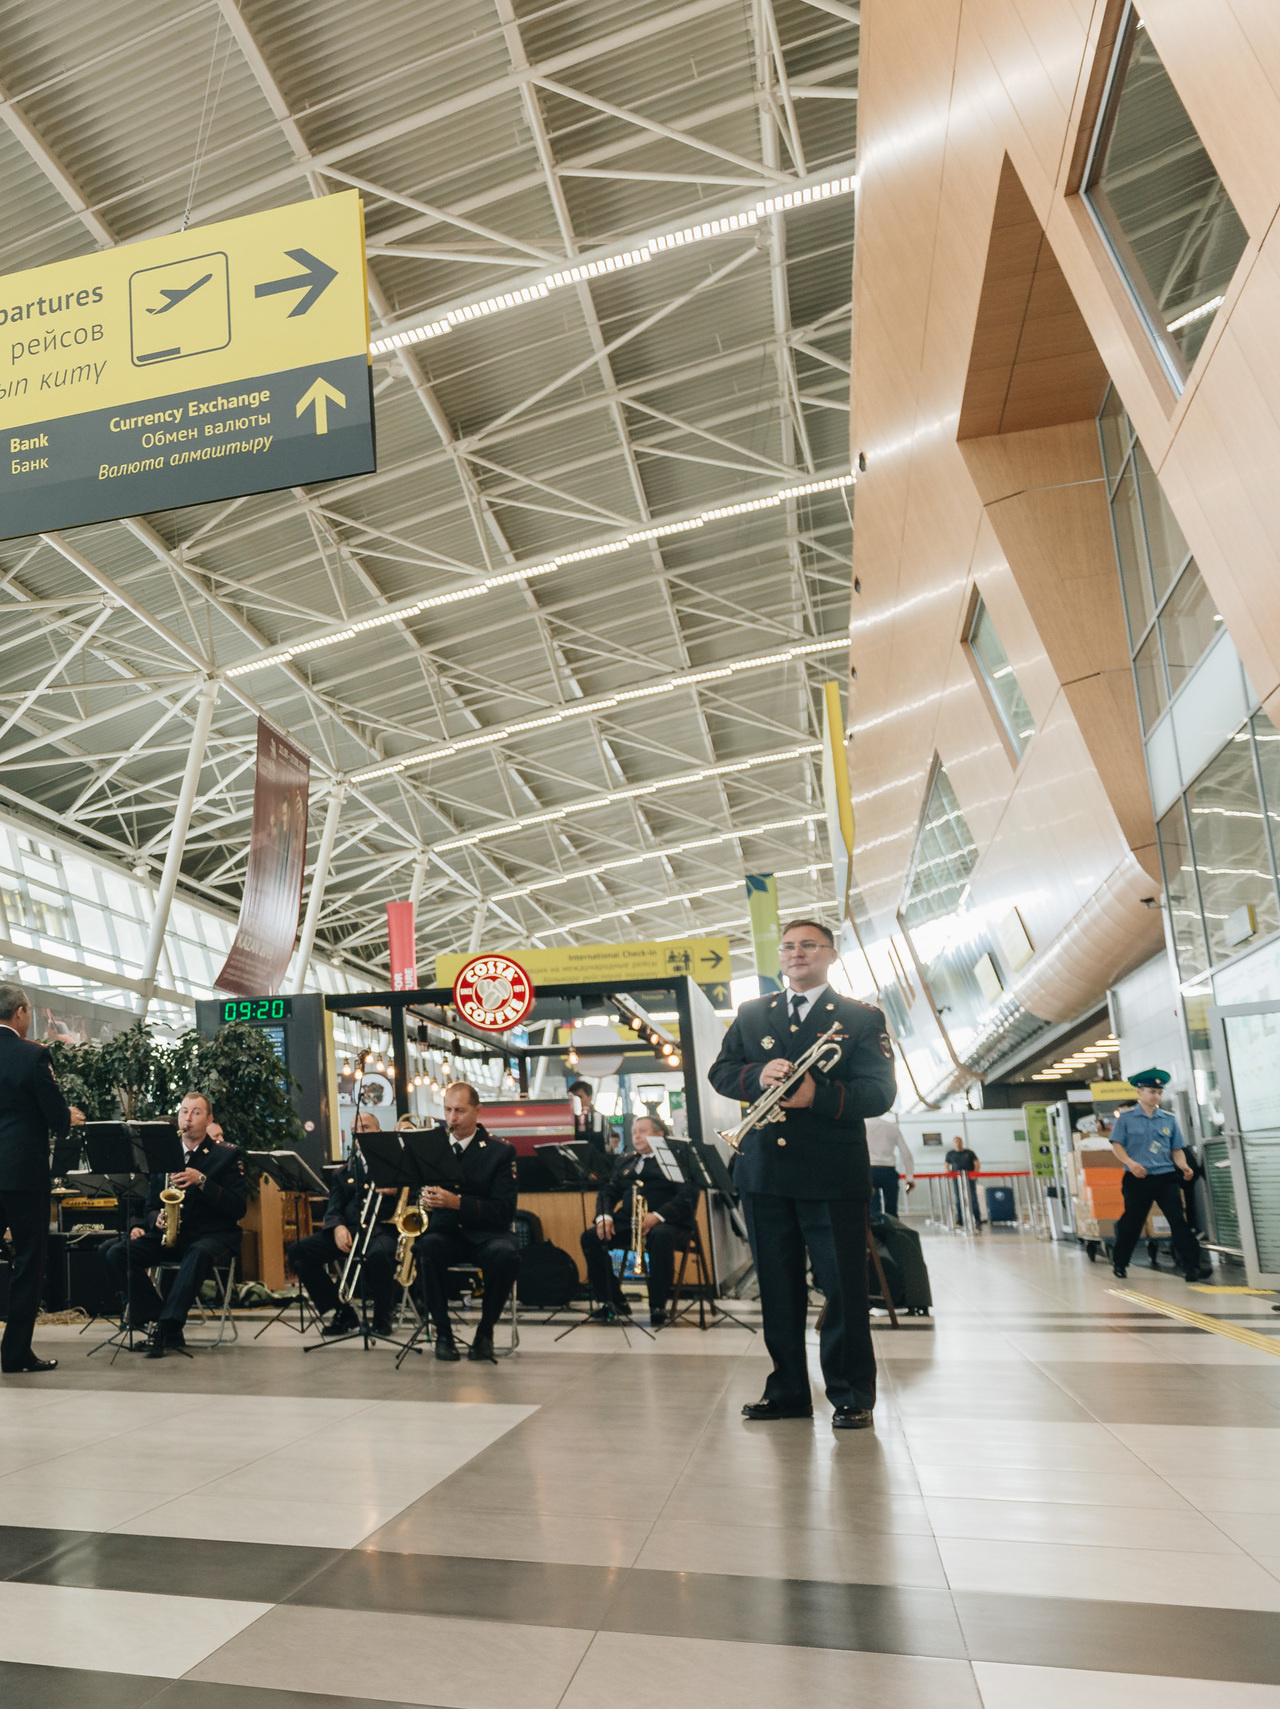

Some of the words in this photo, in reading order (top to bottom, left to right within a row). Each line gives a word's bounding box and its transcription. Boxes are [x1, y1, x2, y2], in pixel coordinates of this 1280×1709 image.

[12, 323, 104, 364] рейсов
[40, 360, 108, 391] киту
[110, 406, 184, 432] Currency
[188, 390, 270, 417] Exchange
[10, 433, 49, 453] Bank
[142, 426, 198, 448] Обмен
[204, 413, 271, 436] валюты
[11, 457, 49, 474] Банк
[98, 456, 164, 480] Валюта
[170, 435, 274, 466] алмаштыру
[568, 950, 620, 960] International
[466, 961, 515, 983] COSTA
[225, 1000, 284, 1021] 09:20
[464, 998, 524, 1024] COFFEE
